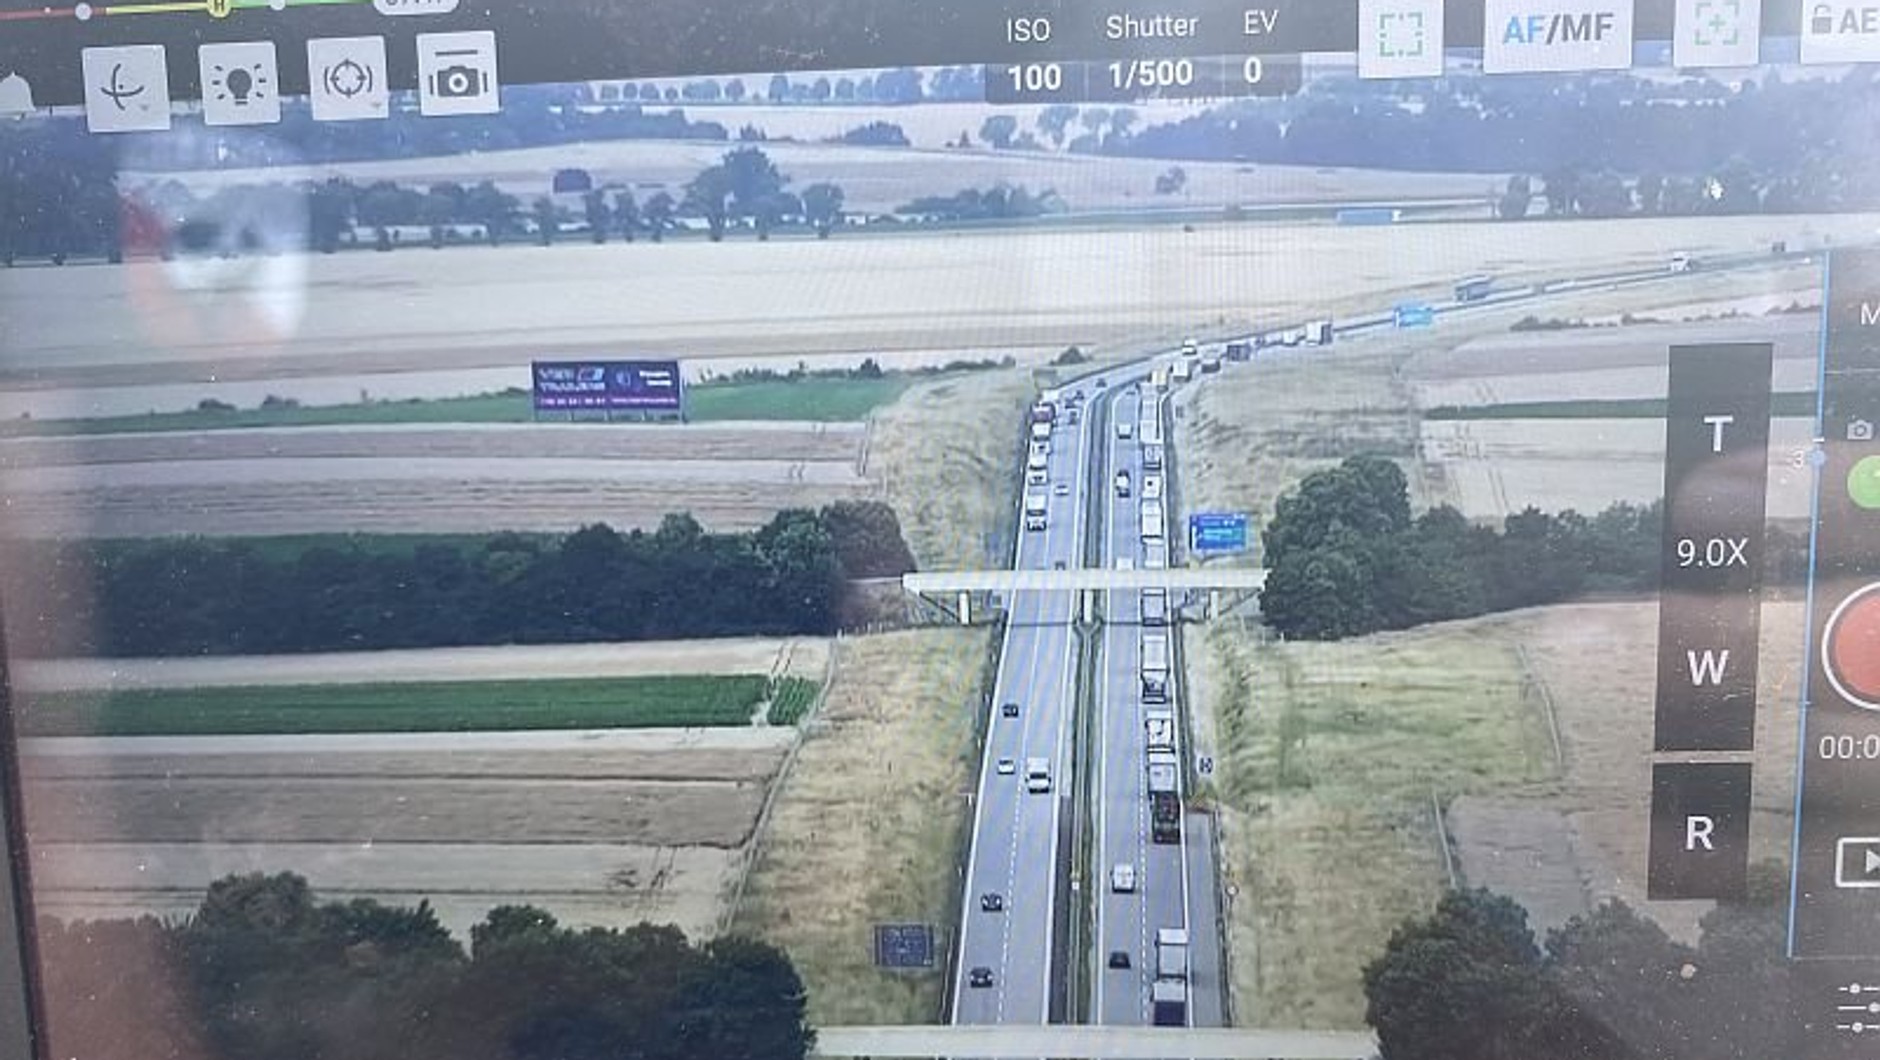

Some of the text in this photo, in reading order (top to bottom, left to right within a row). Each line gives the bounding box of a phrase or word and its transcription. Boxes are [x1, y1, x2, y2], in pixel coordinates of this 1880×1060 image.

[1008, 18, 1051, 42] ISO
[1106, 15, 1199, 40] Shutter
[1244, 10, 1279, 35] EV
[1503, 12, 1614, 45] AF/MF
[1840, 8, 1879, 34] AE
[1008, 64, 1062, 91] 100
[1109, 59, 1194, 88] 1/500
[1244, 56, 1262, 84] 0
[1704, 416, 1734, 451] T
[1678, 537, 1749, 567] 9.0X
[1688, 650, 1730, 686] W
[1686, 815, 1715, 850] R
